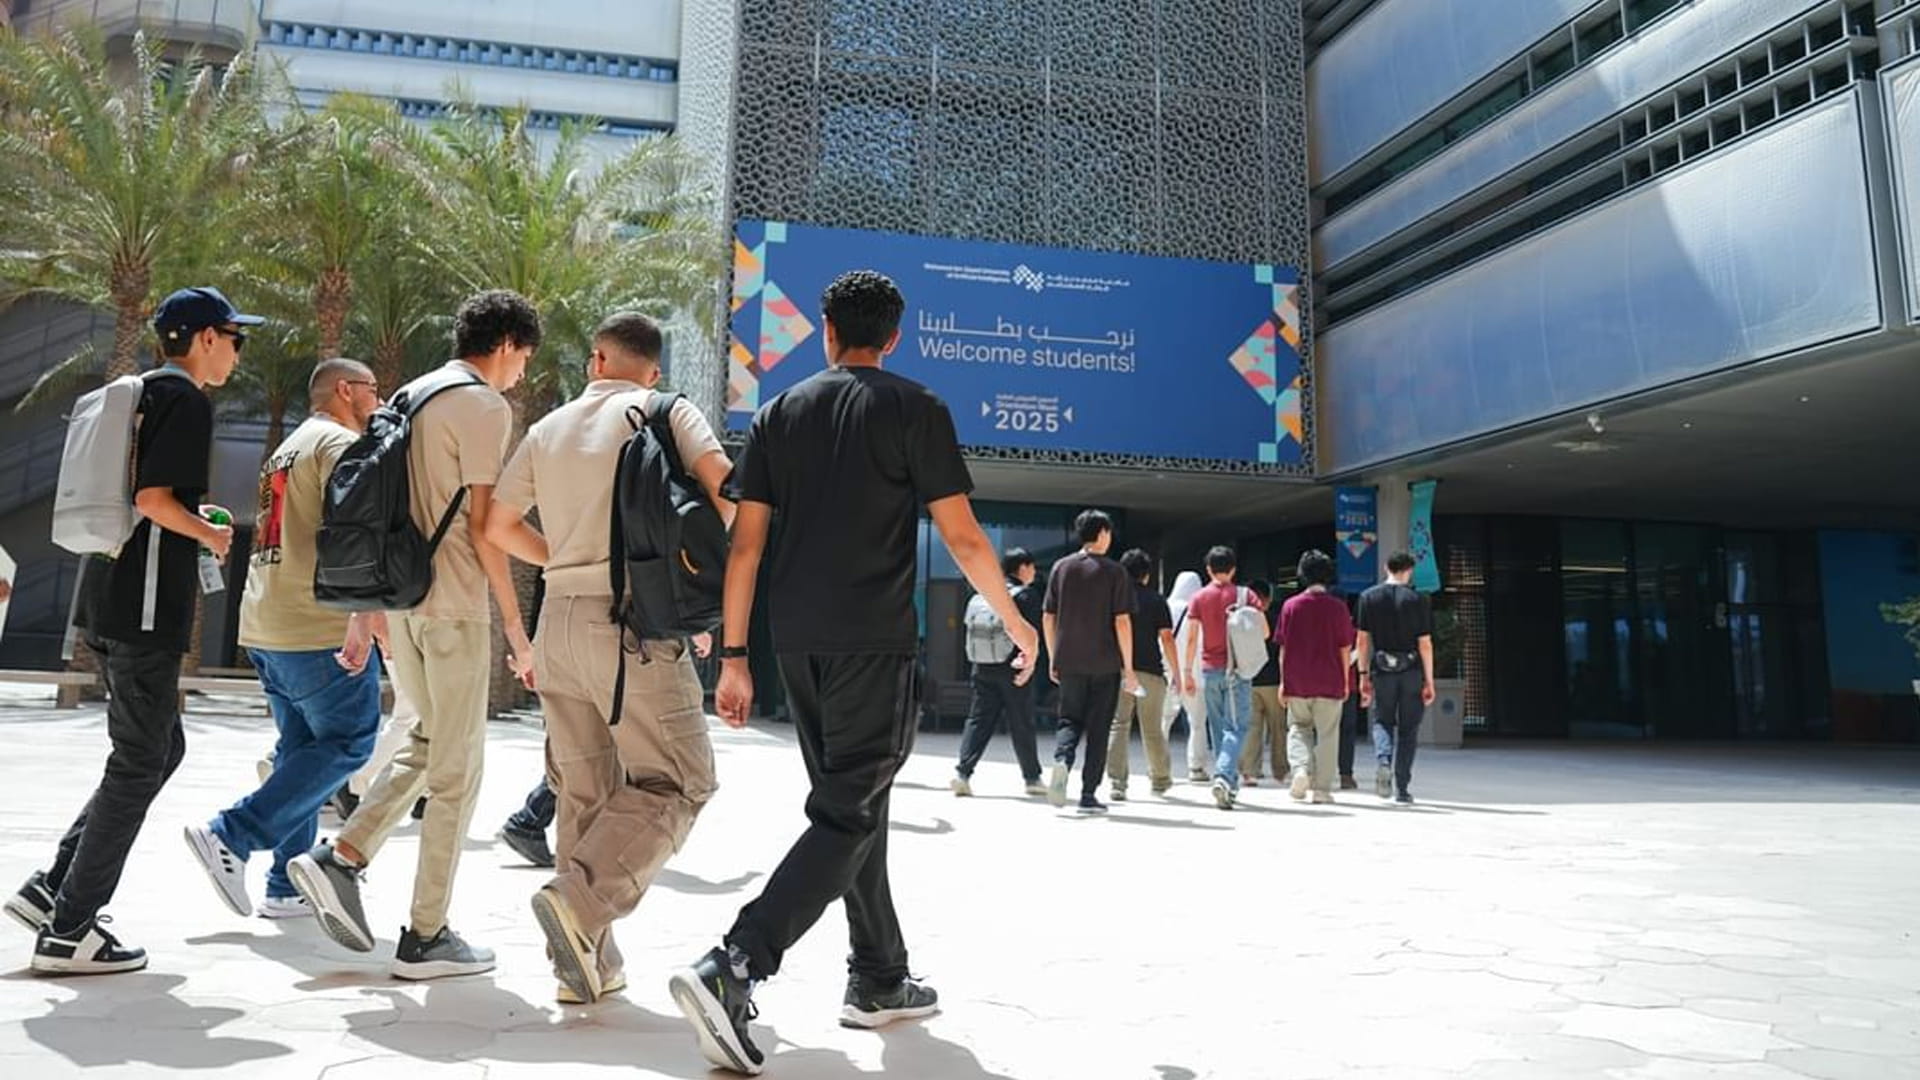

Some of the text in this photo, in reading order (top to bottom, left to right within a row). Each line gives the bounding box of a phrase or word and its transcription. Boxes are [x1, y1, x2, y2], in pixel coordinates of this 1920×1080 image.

[918, 336, 1135, 373] Welcome students!
[995, 409, 1059, 432] 2025
